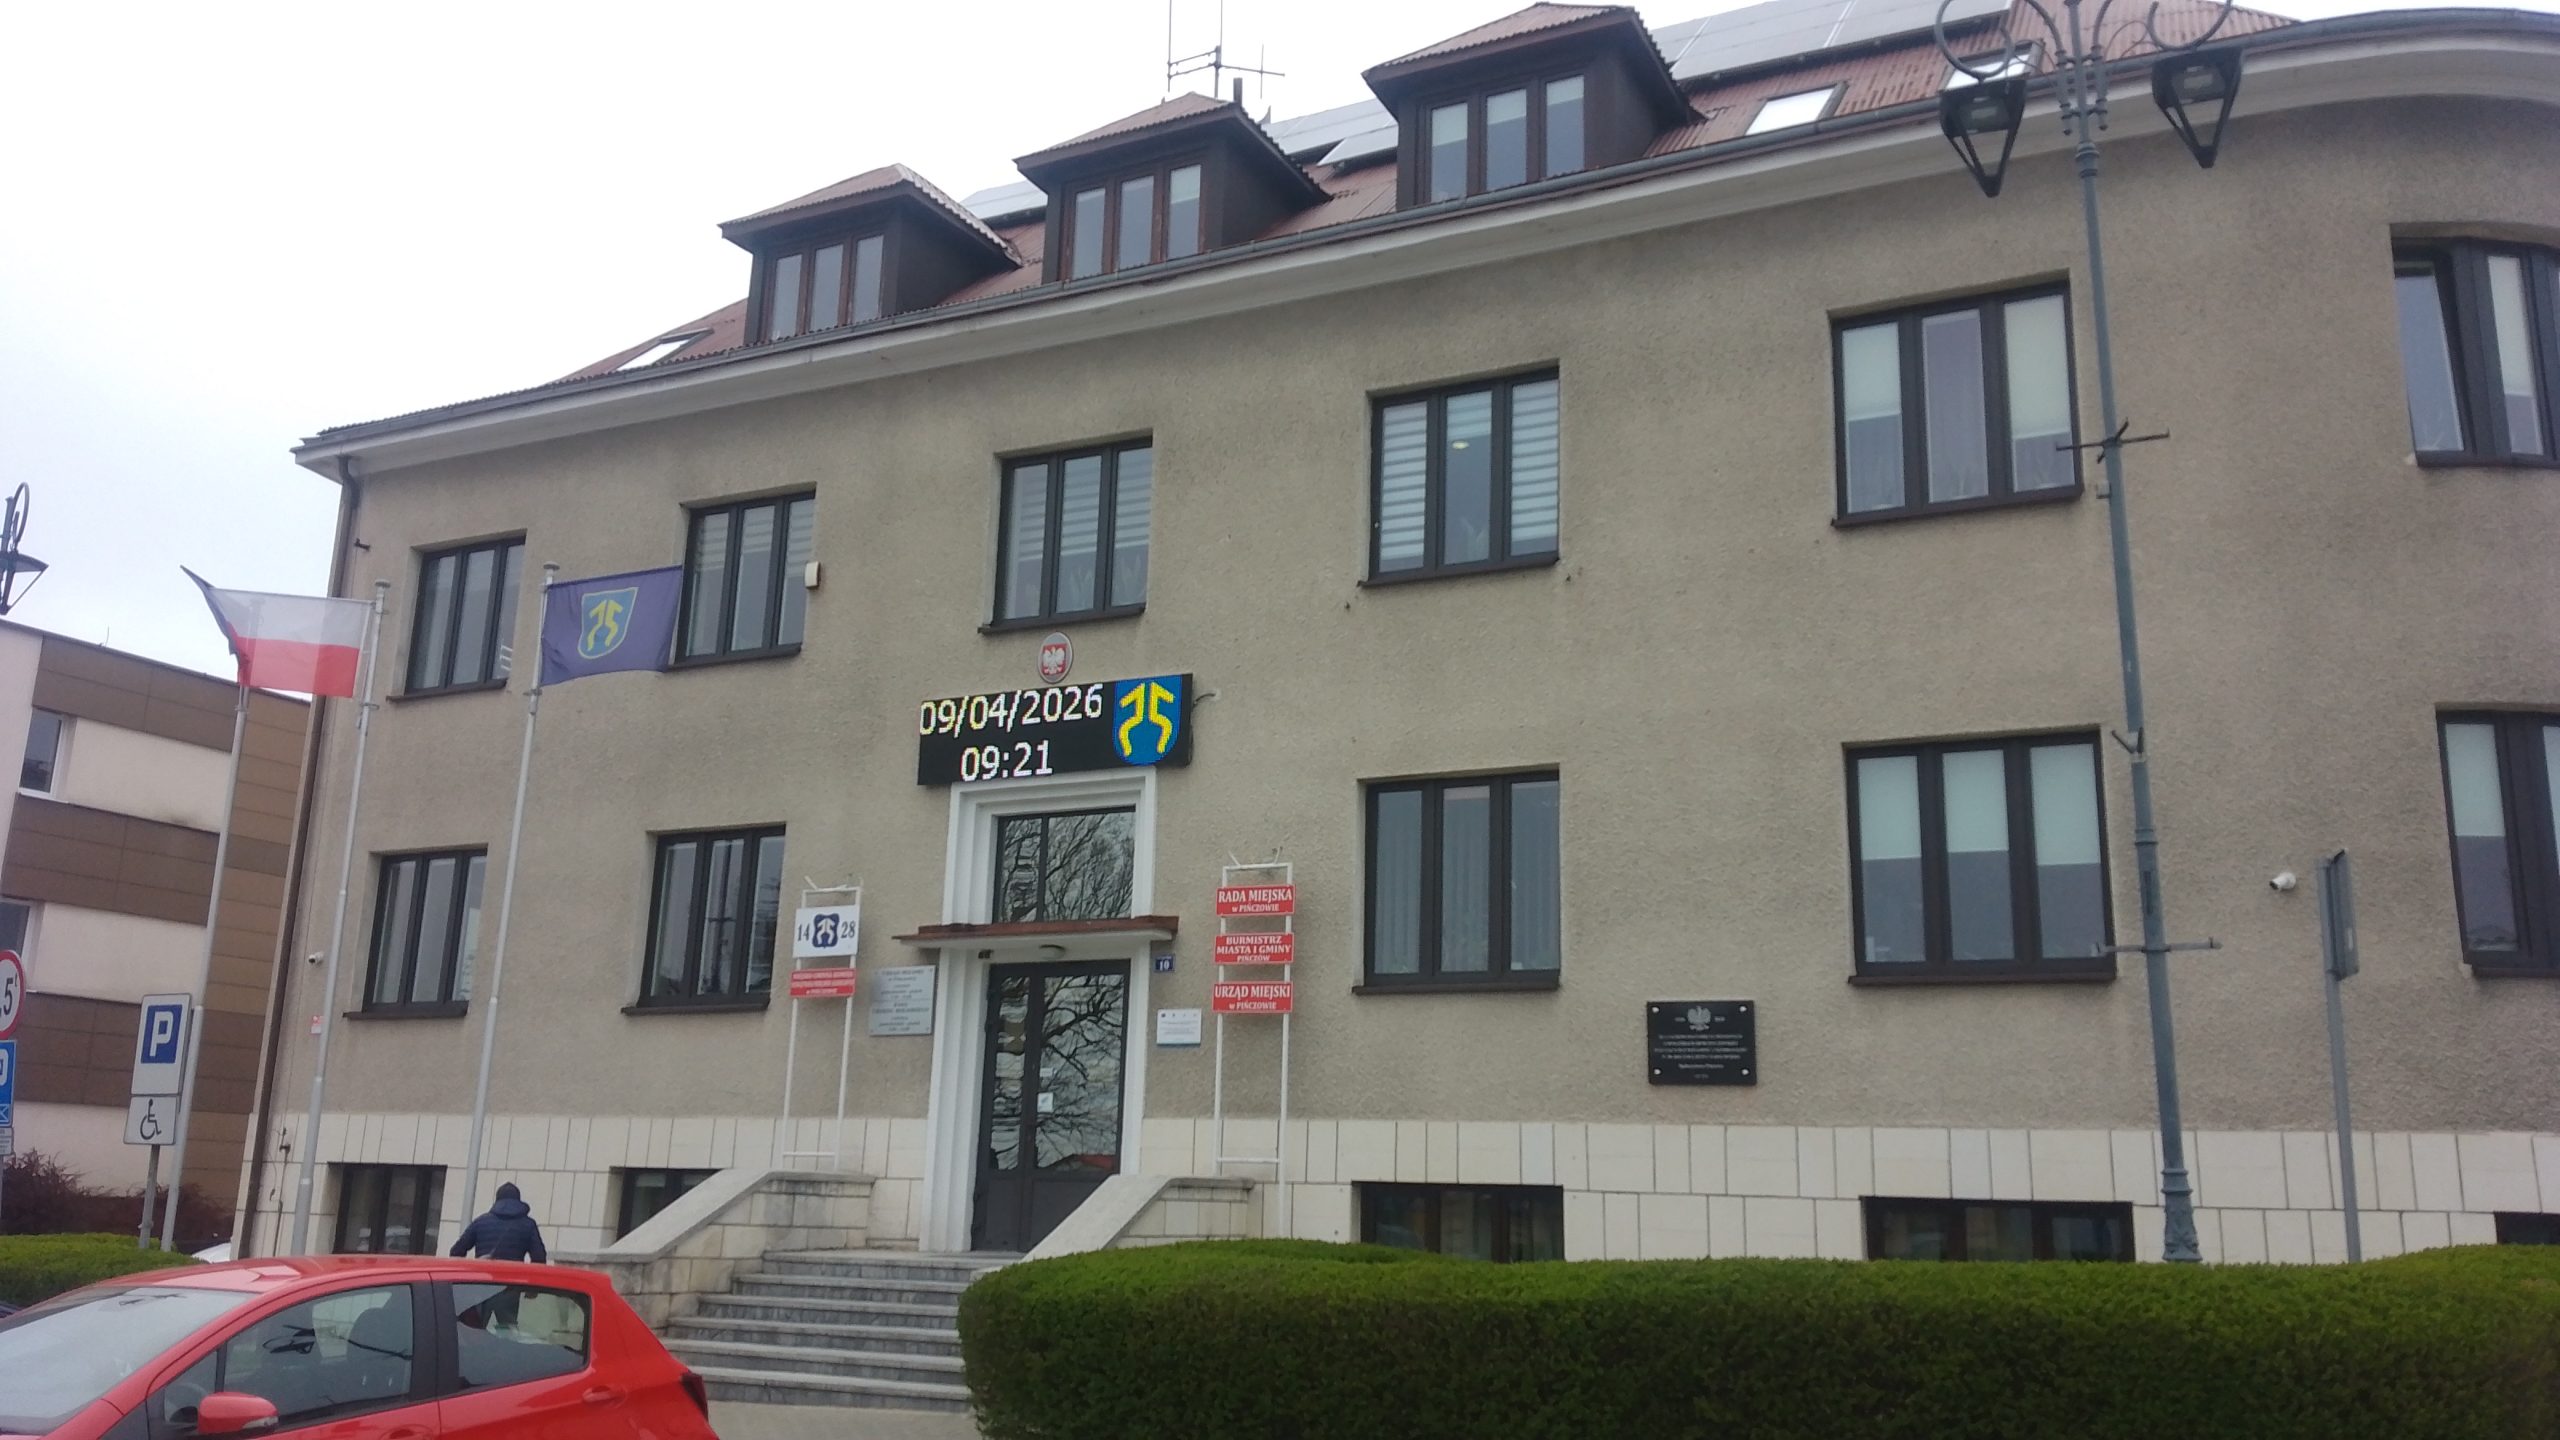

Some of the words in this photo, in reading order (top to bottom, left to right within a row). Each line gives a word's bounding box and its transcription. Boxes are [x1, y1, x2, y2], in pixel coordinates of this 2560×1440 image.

[919, 683, 1103, 738] 09/04/2026
[960, 740, 1053, 782] 09:21
[1218, 890, 1246, 903] RADA
[1248, 888, 1292, 903] MIEJSKA
[1239, 902, 1279, 912] PIŃCZOWIE
[797, 923, 810, 941] 14
[841, 920, 856, 939] 28
[1226, 935, 1282, 945] BURMISTRZ
[1216, 945, 1251, 955] MIASTA
[1258, 944, 1291, 954] GMINY
[1159, 960, 1170, 971] 10
[1214, 985, 1249, 1001] URZĄD
[1250, 985, 1290, 1001] MIEJSKI
[149, 1011, 174, 1057] P
